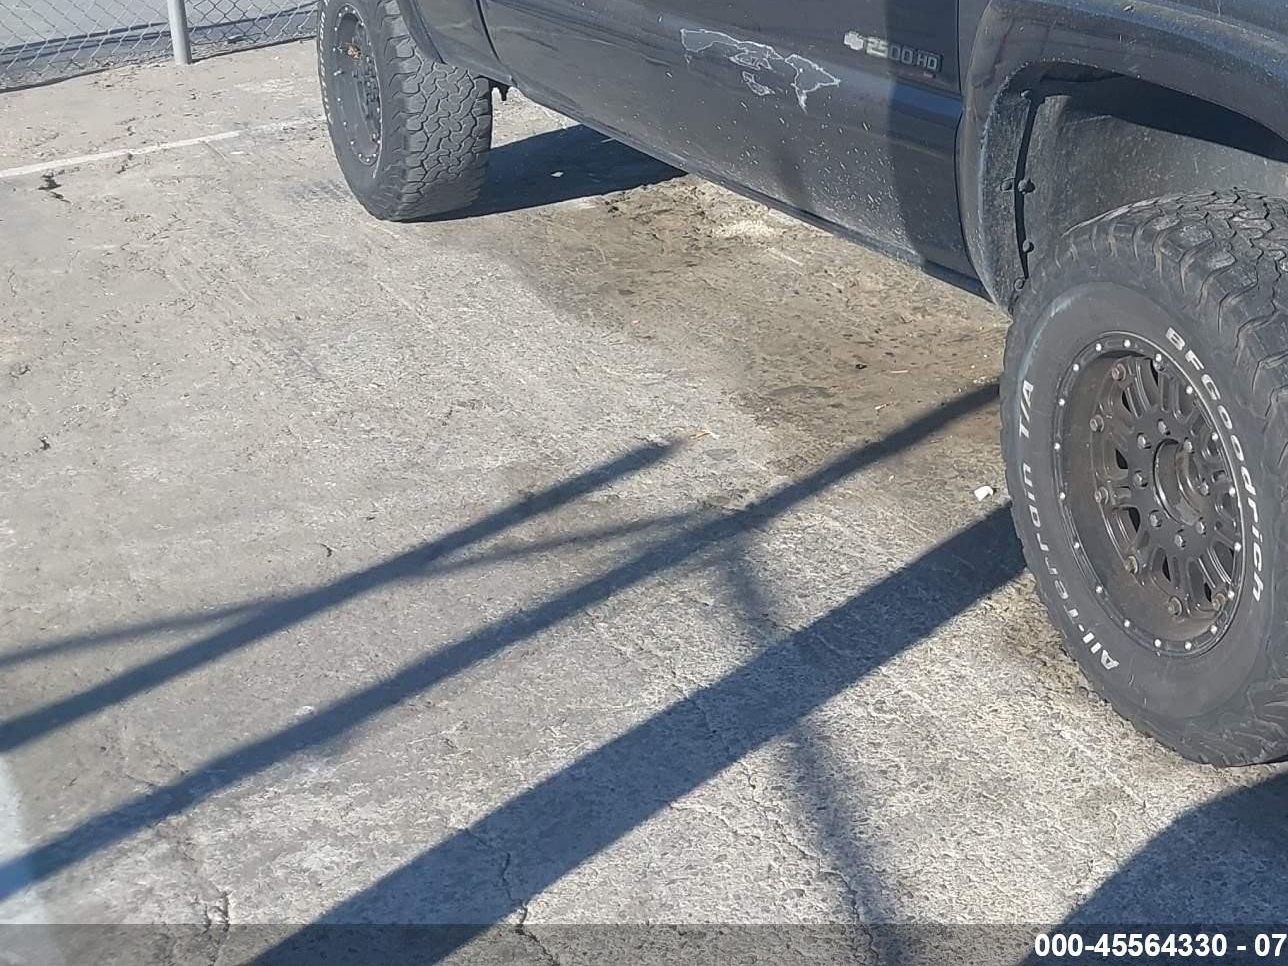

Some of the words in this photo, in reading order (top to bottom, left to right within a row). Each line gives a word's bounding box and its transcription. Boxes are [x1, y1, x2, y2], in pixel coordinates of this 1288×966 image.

[865, 37, 914, 65] 2500
[918, 52, 938, 70] HD
[1019, 379, 1034, 439] T/A
[1166, 327, 1263, 601] BFGoodrich
[1023, 463, 1120, 669] All-Terrain
